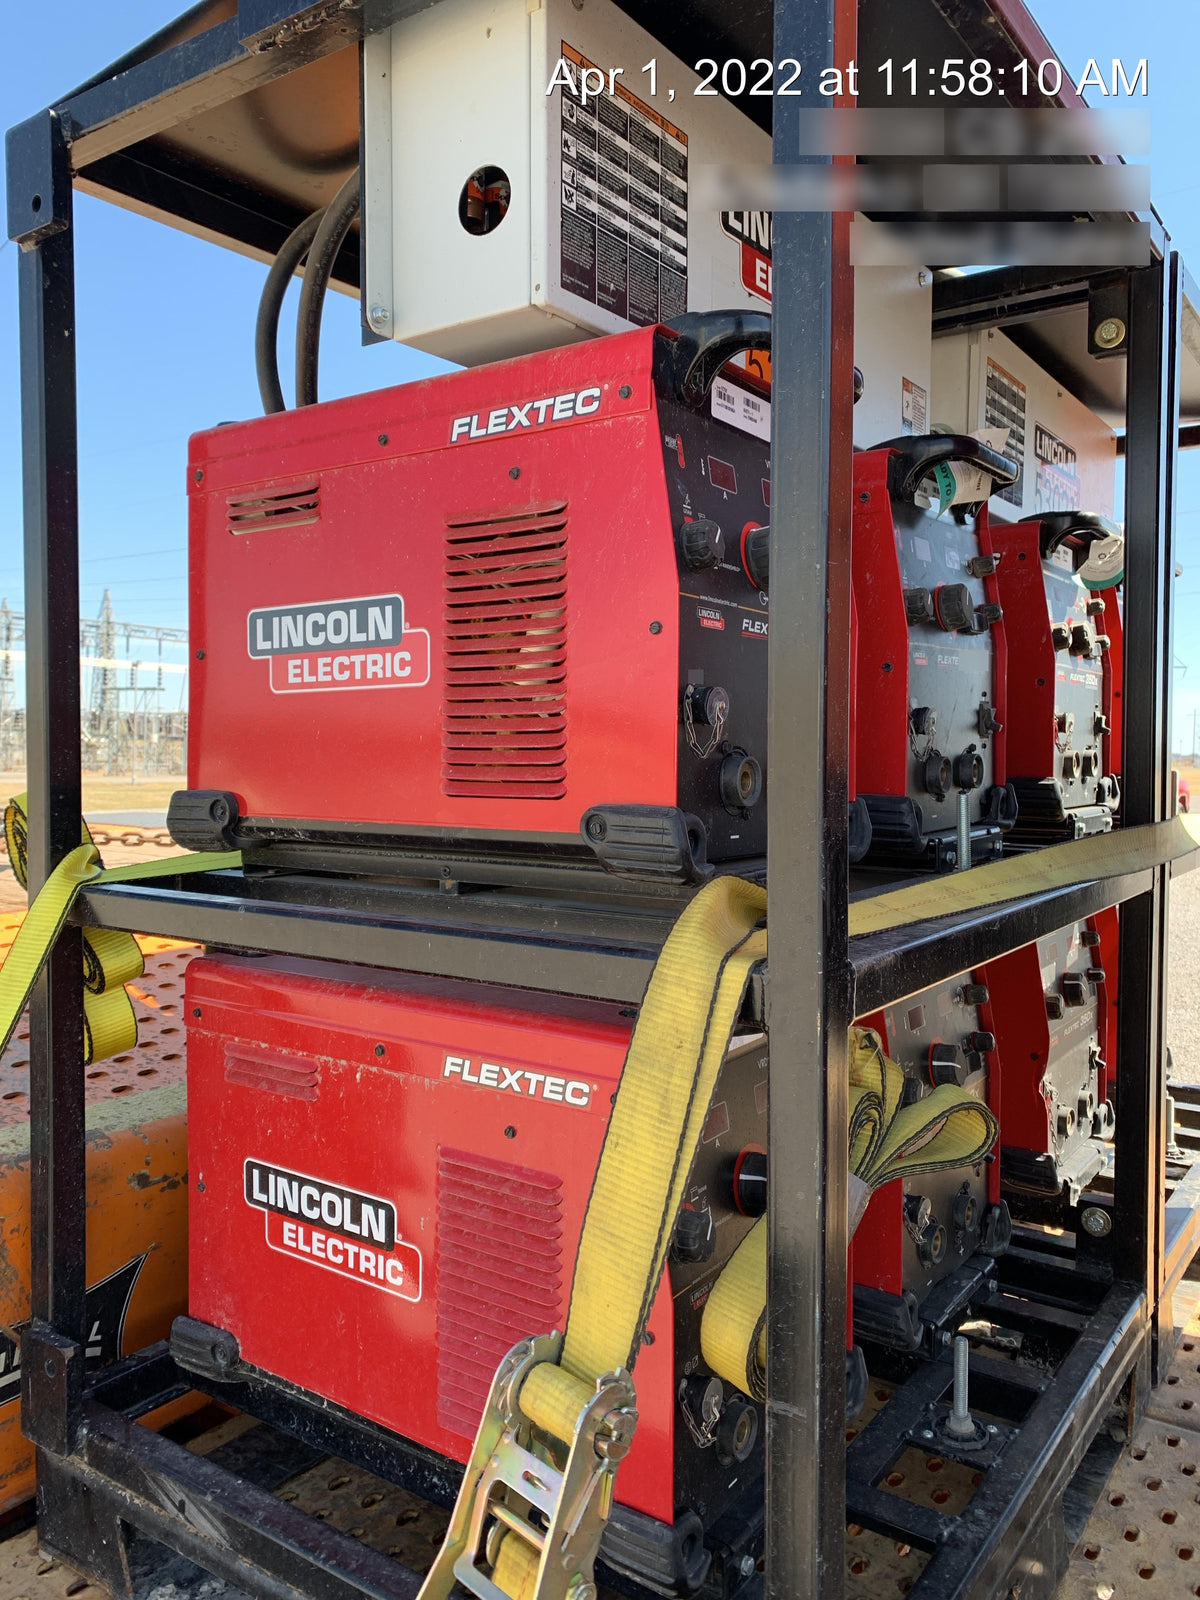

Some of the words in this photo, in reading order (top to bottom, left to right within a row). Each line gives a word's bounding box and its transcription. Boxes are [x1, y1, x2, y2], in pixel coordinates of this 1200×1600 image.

[450, 387, 602, 443] FLEXTEC
[1036, 430, 1077, 478] LINCOLN
[254, 604, 394, 651] LINCOLN
[698, 608, 721, 621] LINCOLN
[287, 650, 413, 685] ELECTRIC
[442, 1055, 591, 1108] FLEXTEC
[250, 1168, 387, 1244] LINCOLN
[282, 1222, 404, 1288] ELECTRIC
